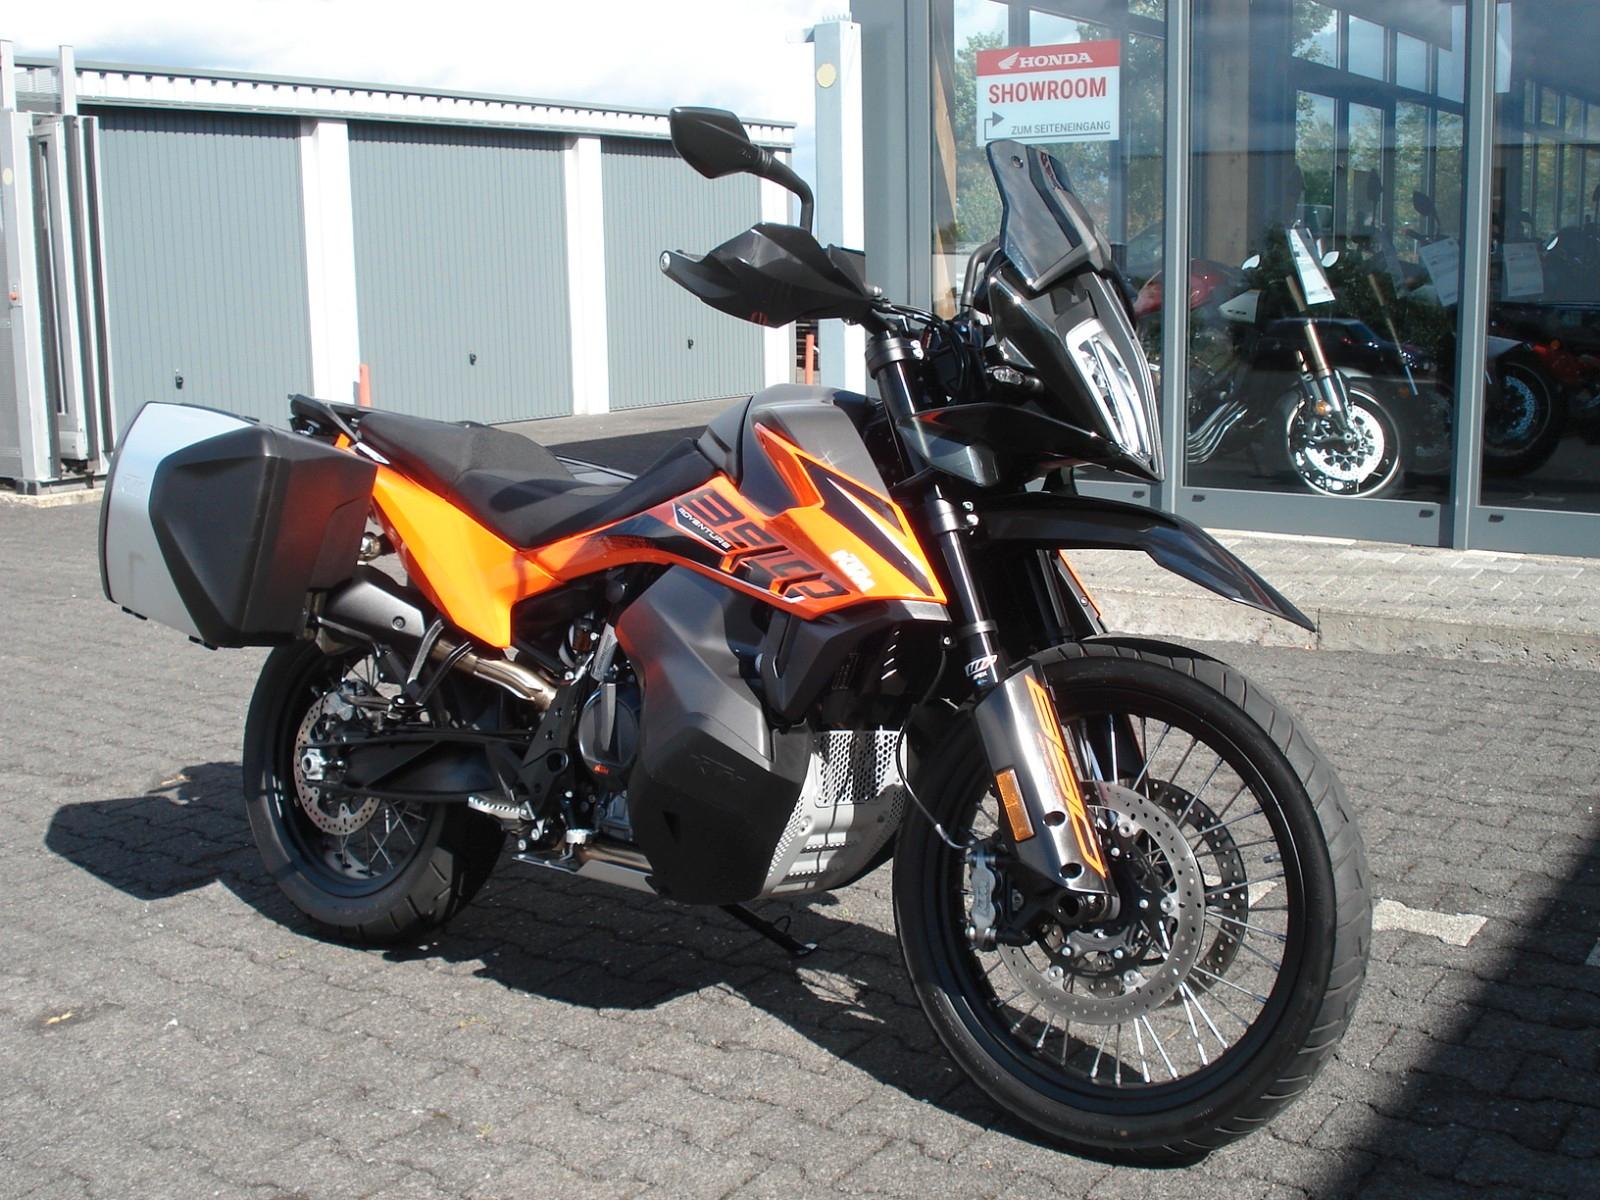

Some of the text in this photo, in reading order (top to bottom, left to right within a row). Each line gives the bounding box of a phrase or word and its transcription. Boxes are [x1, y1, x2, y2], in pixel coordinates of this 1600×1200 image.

[1019, 52, 1093, 69] HONDA
[988, 76, 1106, 104] SHOWROOM
[1011, 121, 1111, 135] ZUM SEITENEINGANG
[677, 507, 731, 549] ADVENTURE
